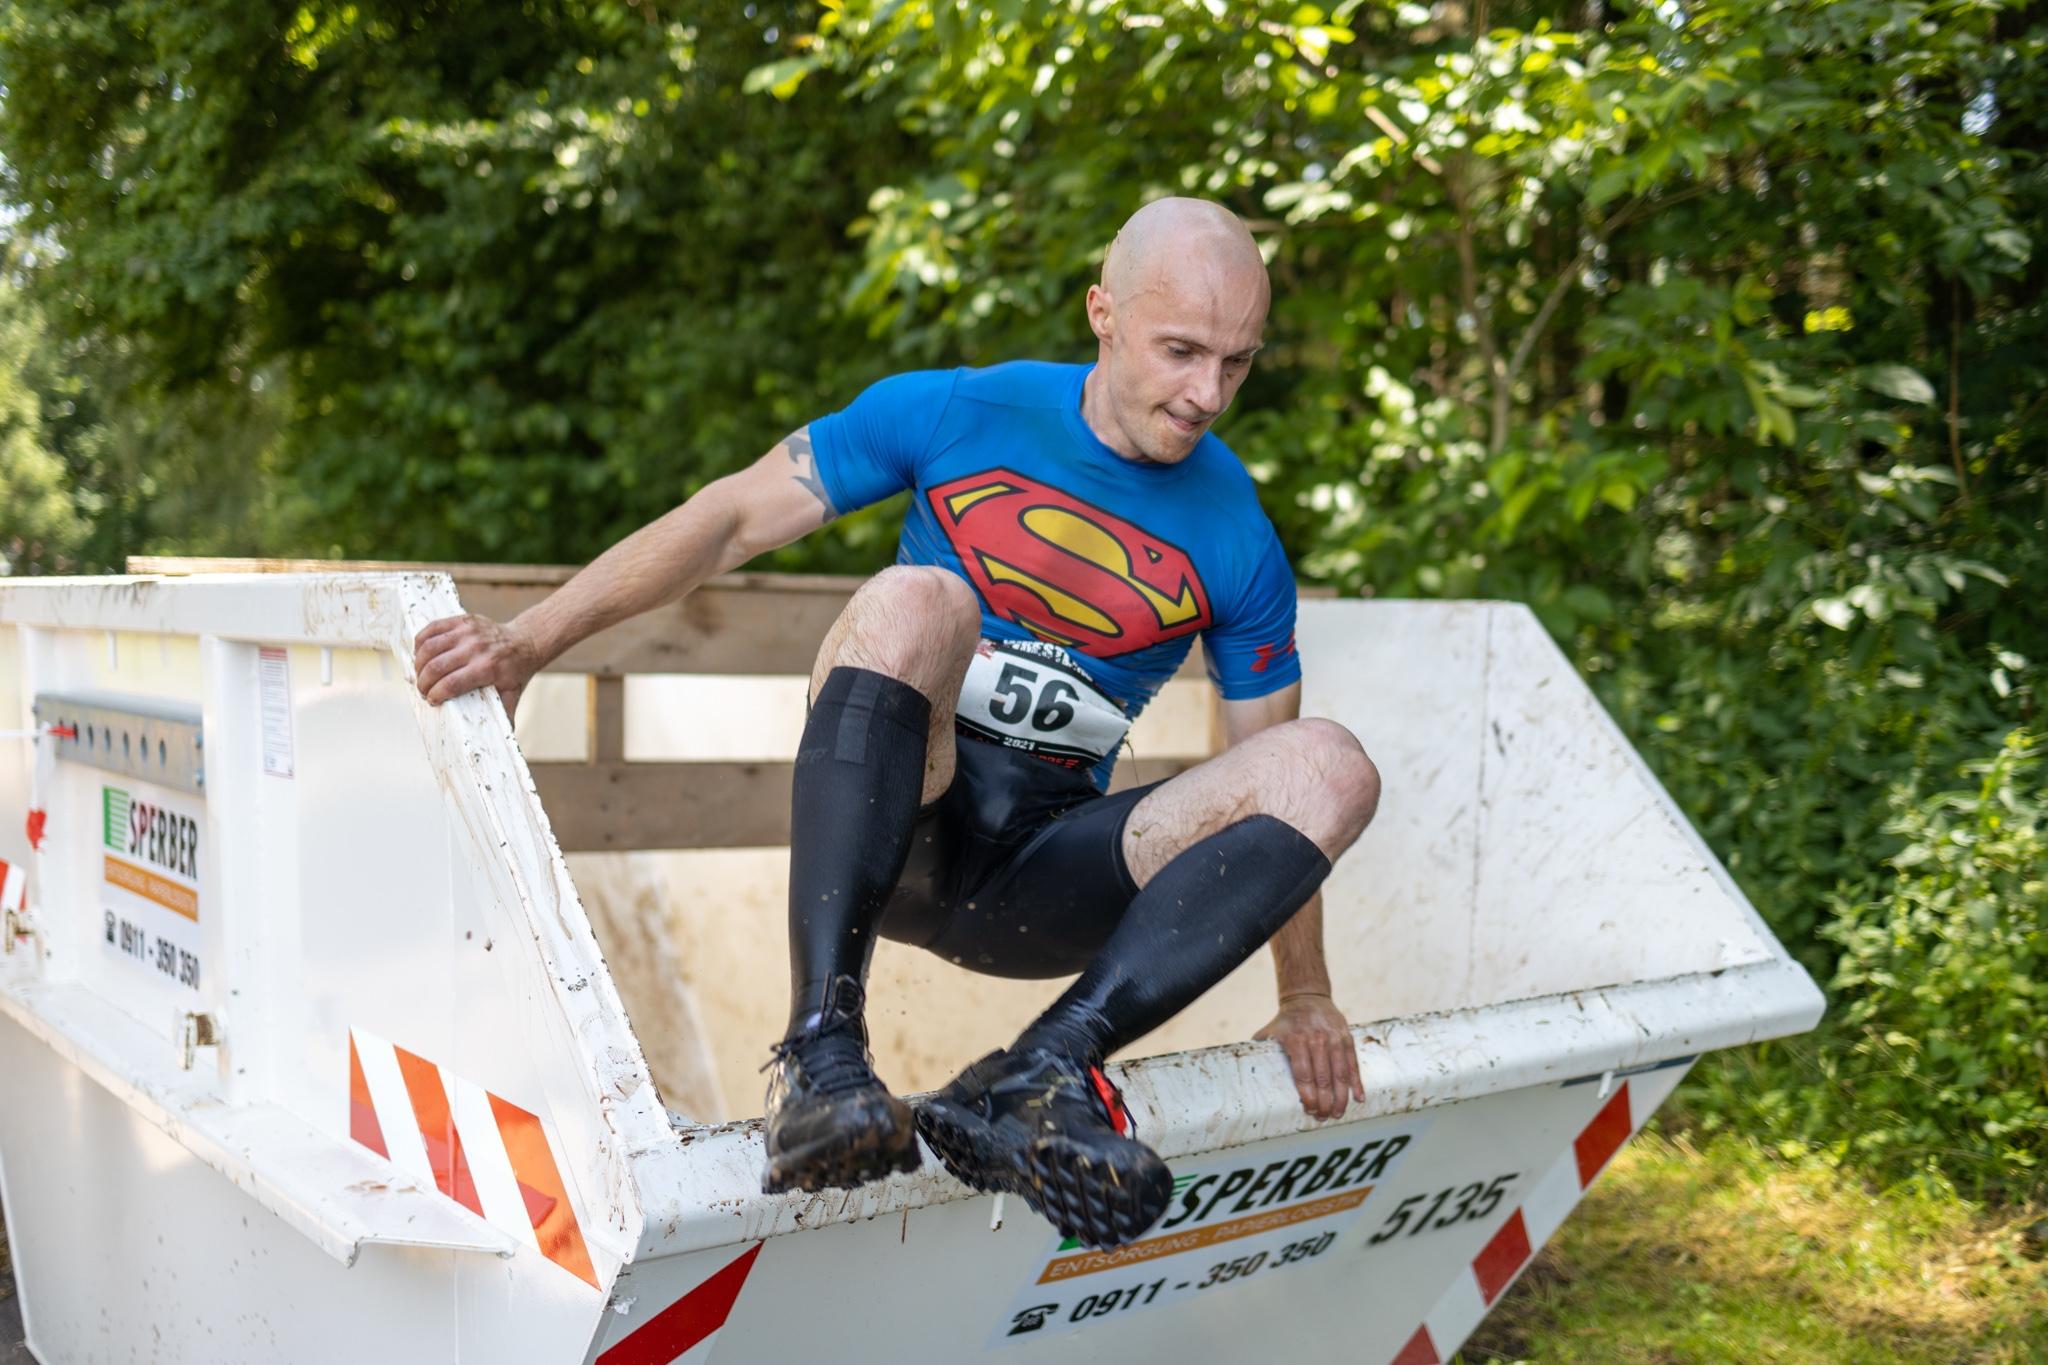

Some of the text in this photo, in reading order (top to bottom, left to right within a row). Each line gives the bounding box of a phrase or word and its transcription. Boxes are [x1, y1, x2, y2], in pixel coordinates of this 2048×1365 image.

[989, 662, 1080, 732] 56
[1003, 736, 1036, 751] 2021
[129, 798, 198, 881] SPERBER
[119, 917, 145, 962] 0911
[156, 935, 177, 978] 350
[179, 947, 199, 991] 350
[1161, 1134, 1412, 1229] SPERBER
[1367, 1172, 1521, 1246] 5135
[1049, 1233, 1200, 1277] ENTSORGUNG
[1068, 1277, 1167, 1323] 0911
[1197, 1250, 1269, 1290] 350
[1270, 1231, 1338, 1269] 350
